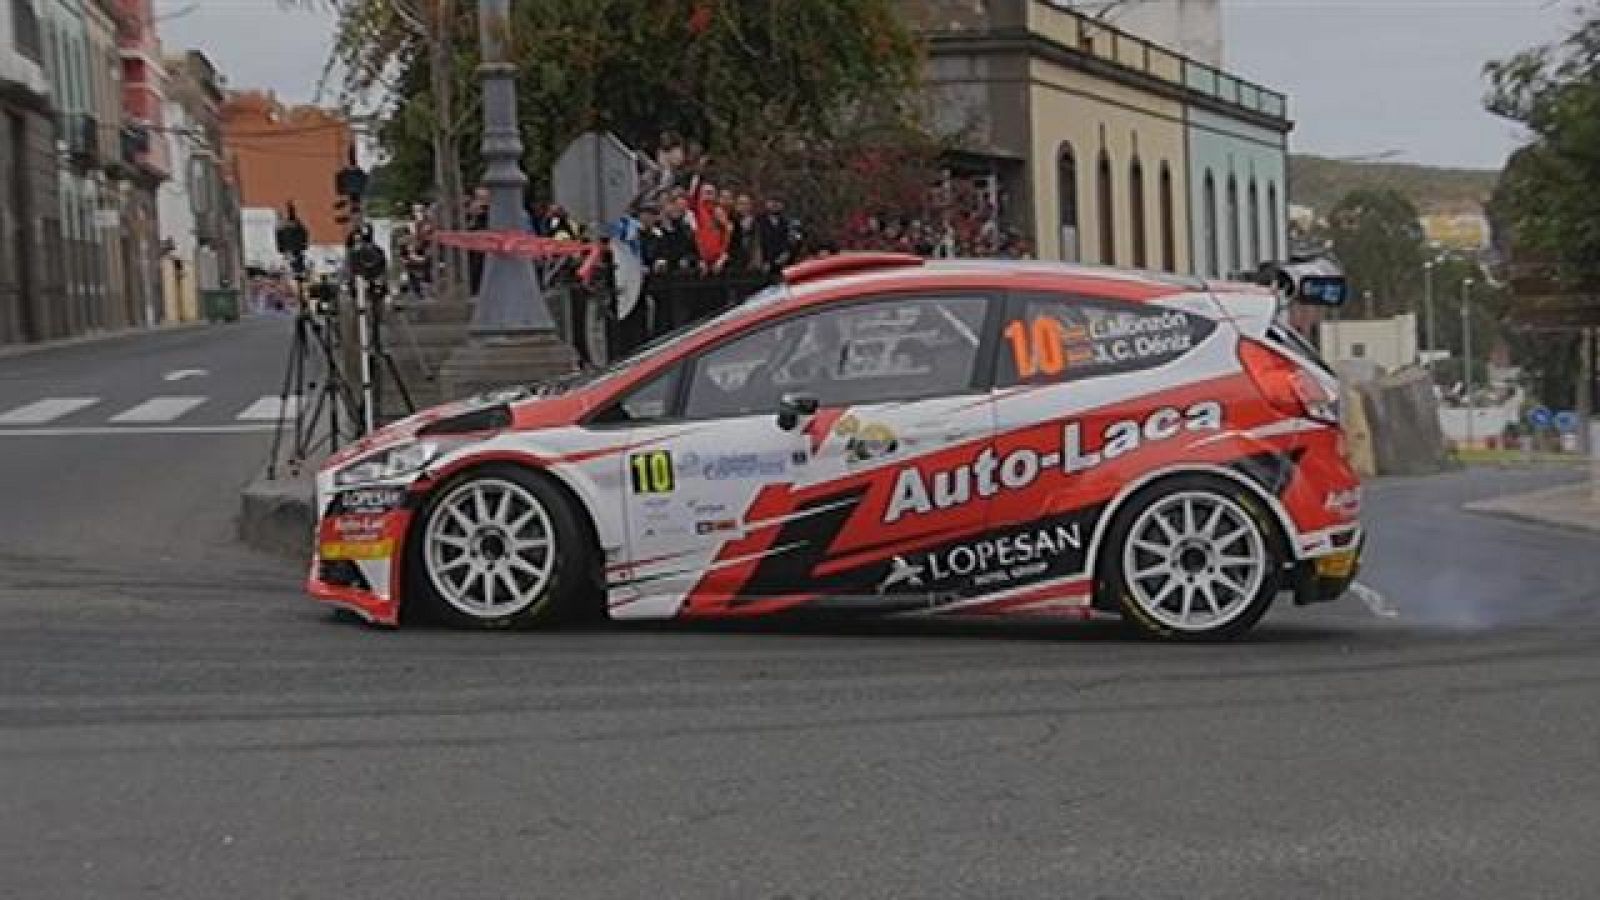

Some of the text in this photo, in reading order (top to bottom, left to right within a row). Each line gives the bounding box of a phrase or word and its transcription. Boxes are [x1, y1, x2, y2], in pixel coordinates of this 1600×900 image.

[1005, 317, 1066, 377] 10
[633, 451, 671, 492] 10
[883, 401, 1222, 522] Auto-Laca
[928, 523, 1081, 580] LOPESAN
